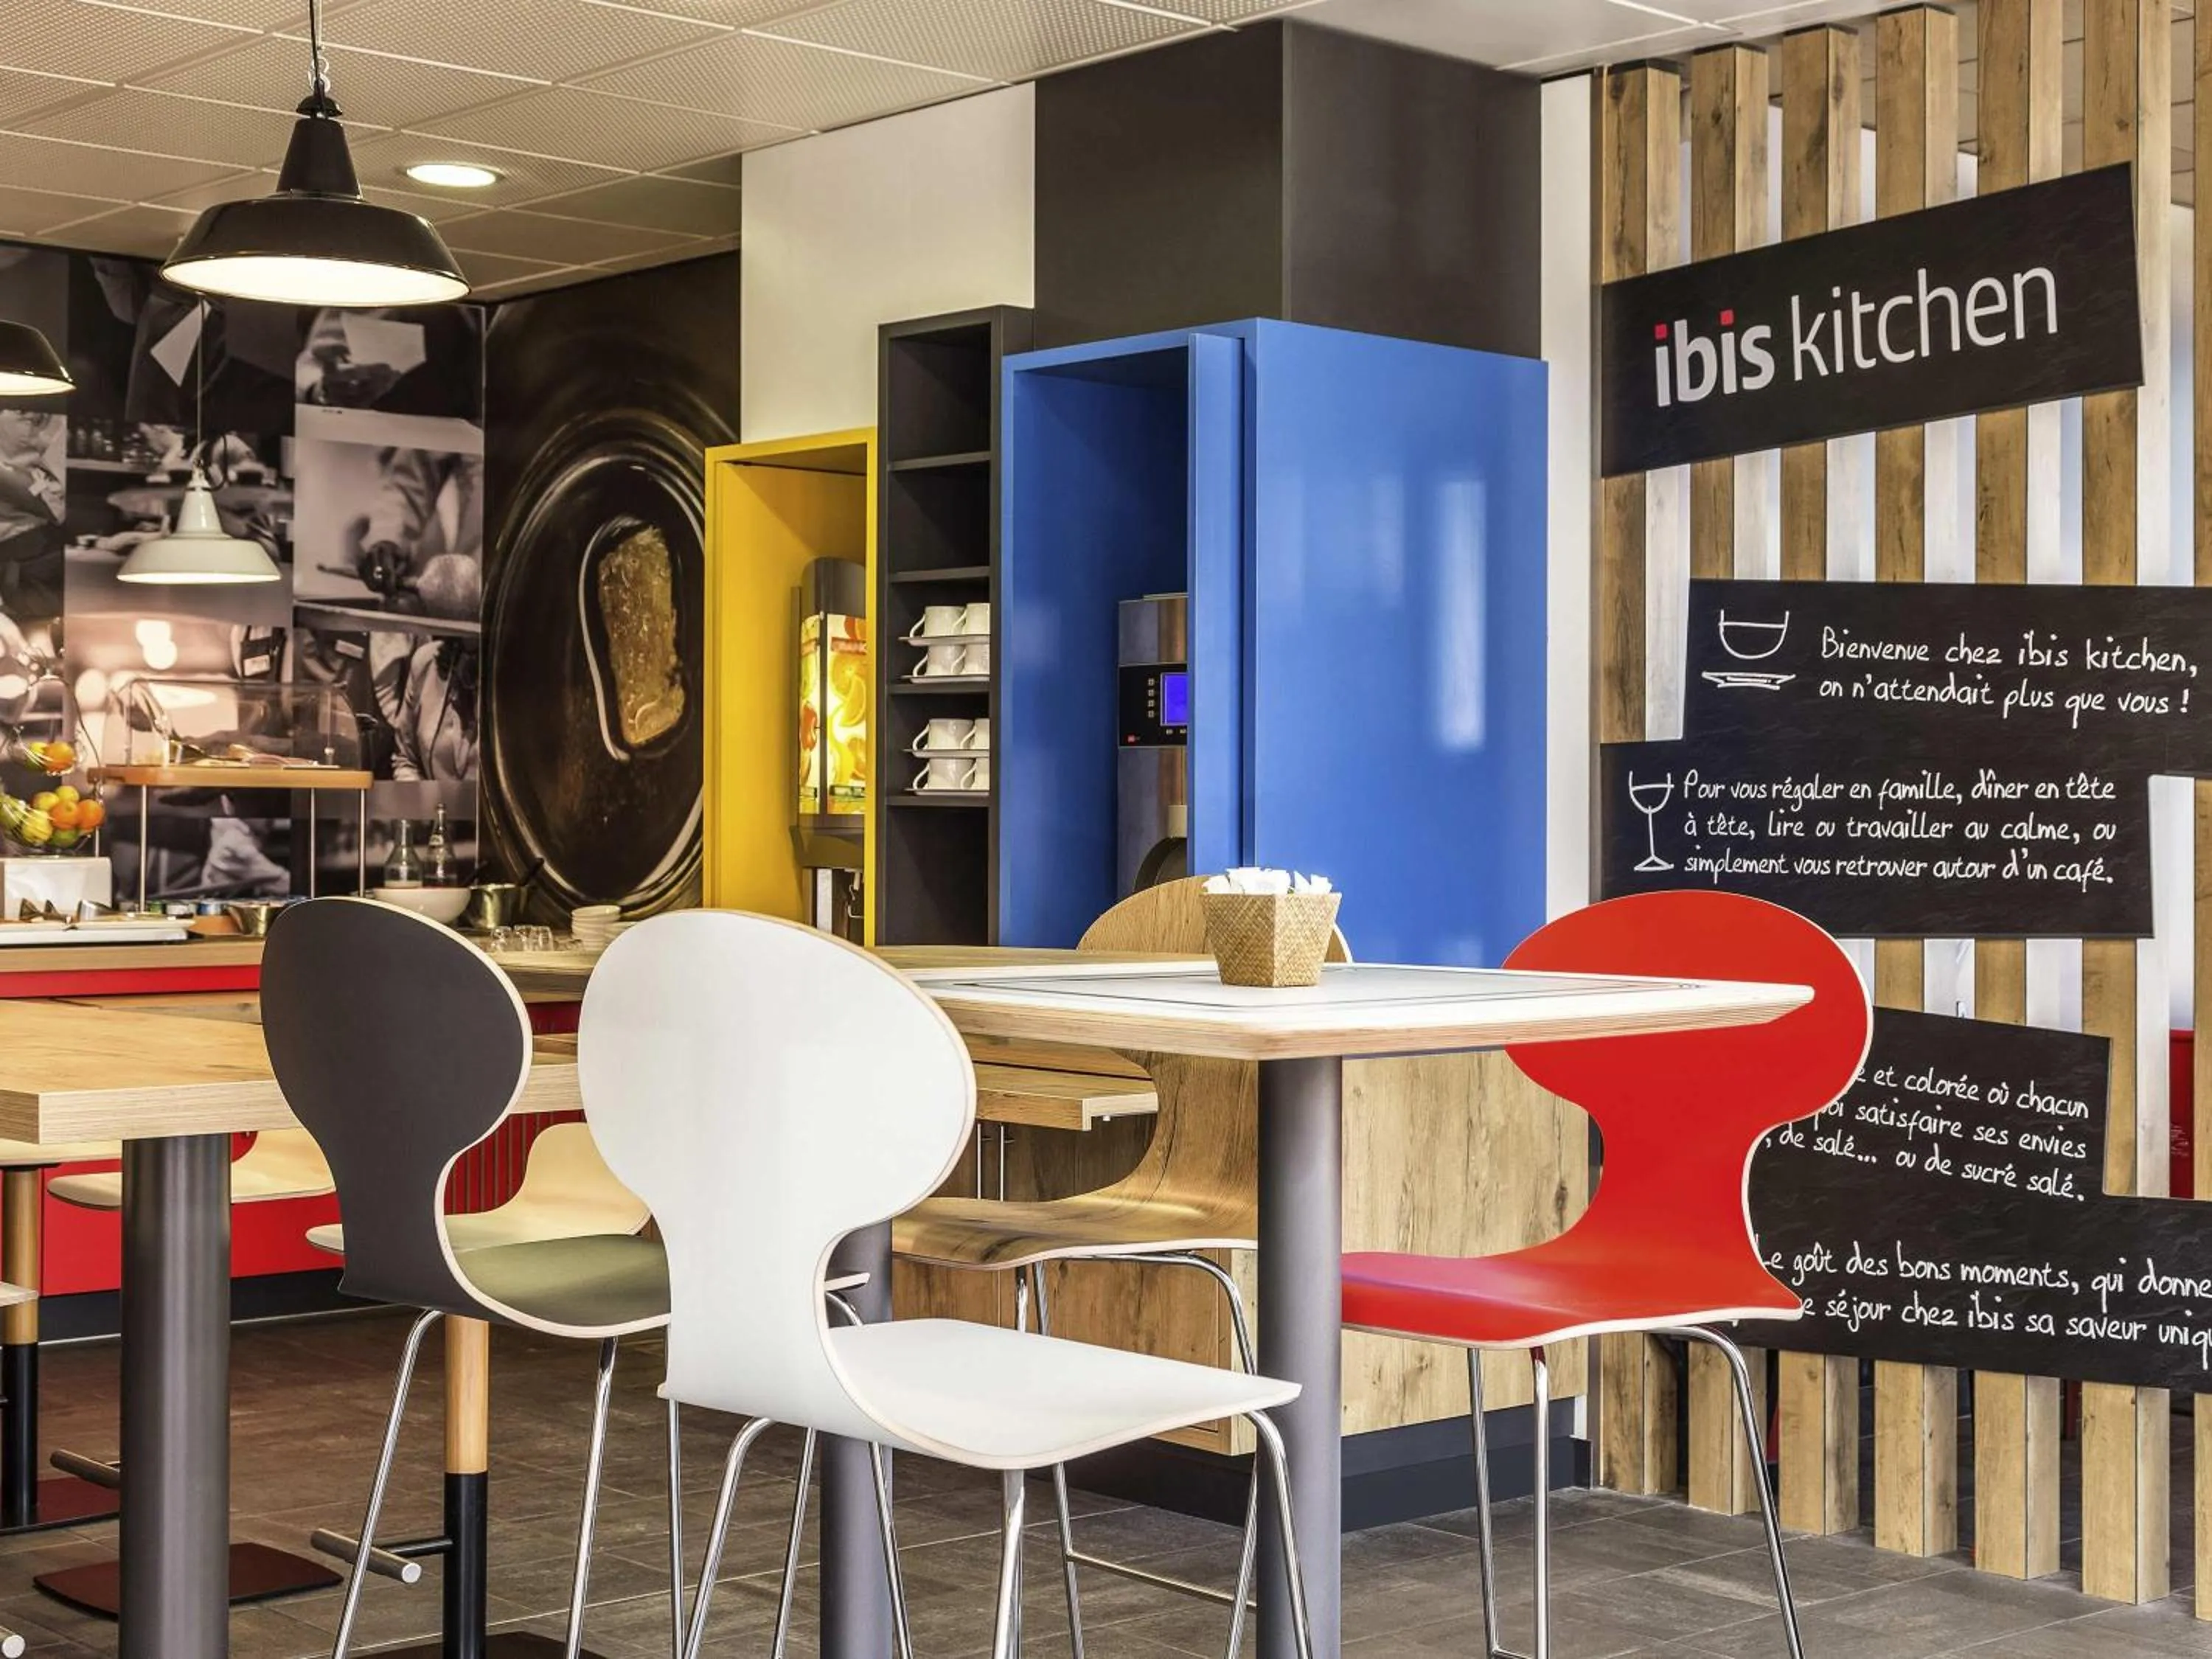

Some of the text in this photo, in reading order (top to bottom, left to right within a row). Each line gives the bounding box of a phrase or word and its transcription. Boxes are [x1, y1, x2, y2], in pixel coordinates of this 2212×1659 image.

[1655, 268, 2058, 406] ibis kitchen
[1820, 625, 2198, 678] Bienvenue chez ibis kitchen,
[1819, 680, 1843, 698] on
[1851, 671, 1994, 706] n'attendait
[2003, 678, 2054, 720] plus
[2064, 692, 2107, 729] que
[2117, 692, 2169, 714] vous
[1683, 768, 2117, 815] Pour vous régaler en famille, dîner en tête
[1684, 807, 2117, 845] à tête, lire ou travailler au calme, ou
[1683, 844, 1790, 885] simplement
[1793, 857, 1831, 875] vous
[1933, 856, 1997, 880] autour
[2001, 847, 2048, 880] d'un
[2052, 857, 2114, 894] café.
[1873, 1065, 1898, 1088] et
[1904, 1066, 1980, 1102] colorée
[1987, 1082, 2009, 1105] où
[2015, 1079, 2089, 1119] chacun
[1854, 1096, 1964, 1141] satisfaire
[1972, 1126, 2009, 1145] ses
[2018, 1124, 2087, 1159] envies
[1778, 1121, 1806, 1149] de
[1895, 1150, 1917, 1169] ou
[1924, 1142, 1953, 1176] de
[1961, 1163, 2017, 1188] sucré
[2025, 1167, 2084, 1202] salé.
[1791, 1241, 1838, 1287] goût
[1846, 1240, 1888, 1276] des
[1896, 1239, 1952, 1281] bons
[1960, 1262, 2079, 1295] moments,
[2090, 1256, 2127, 1314] qui
[1824, 1288, 1892, 1333] séjour
[1901, 1290, 1958, 1326] chez
[1967, 1290, 2015, 1331] ibis
[2024, 1313, 2056, 1336] sa
[2065, 1316, 2148, 1341] saveur
